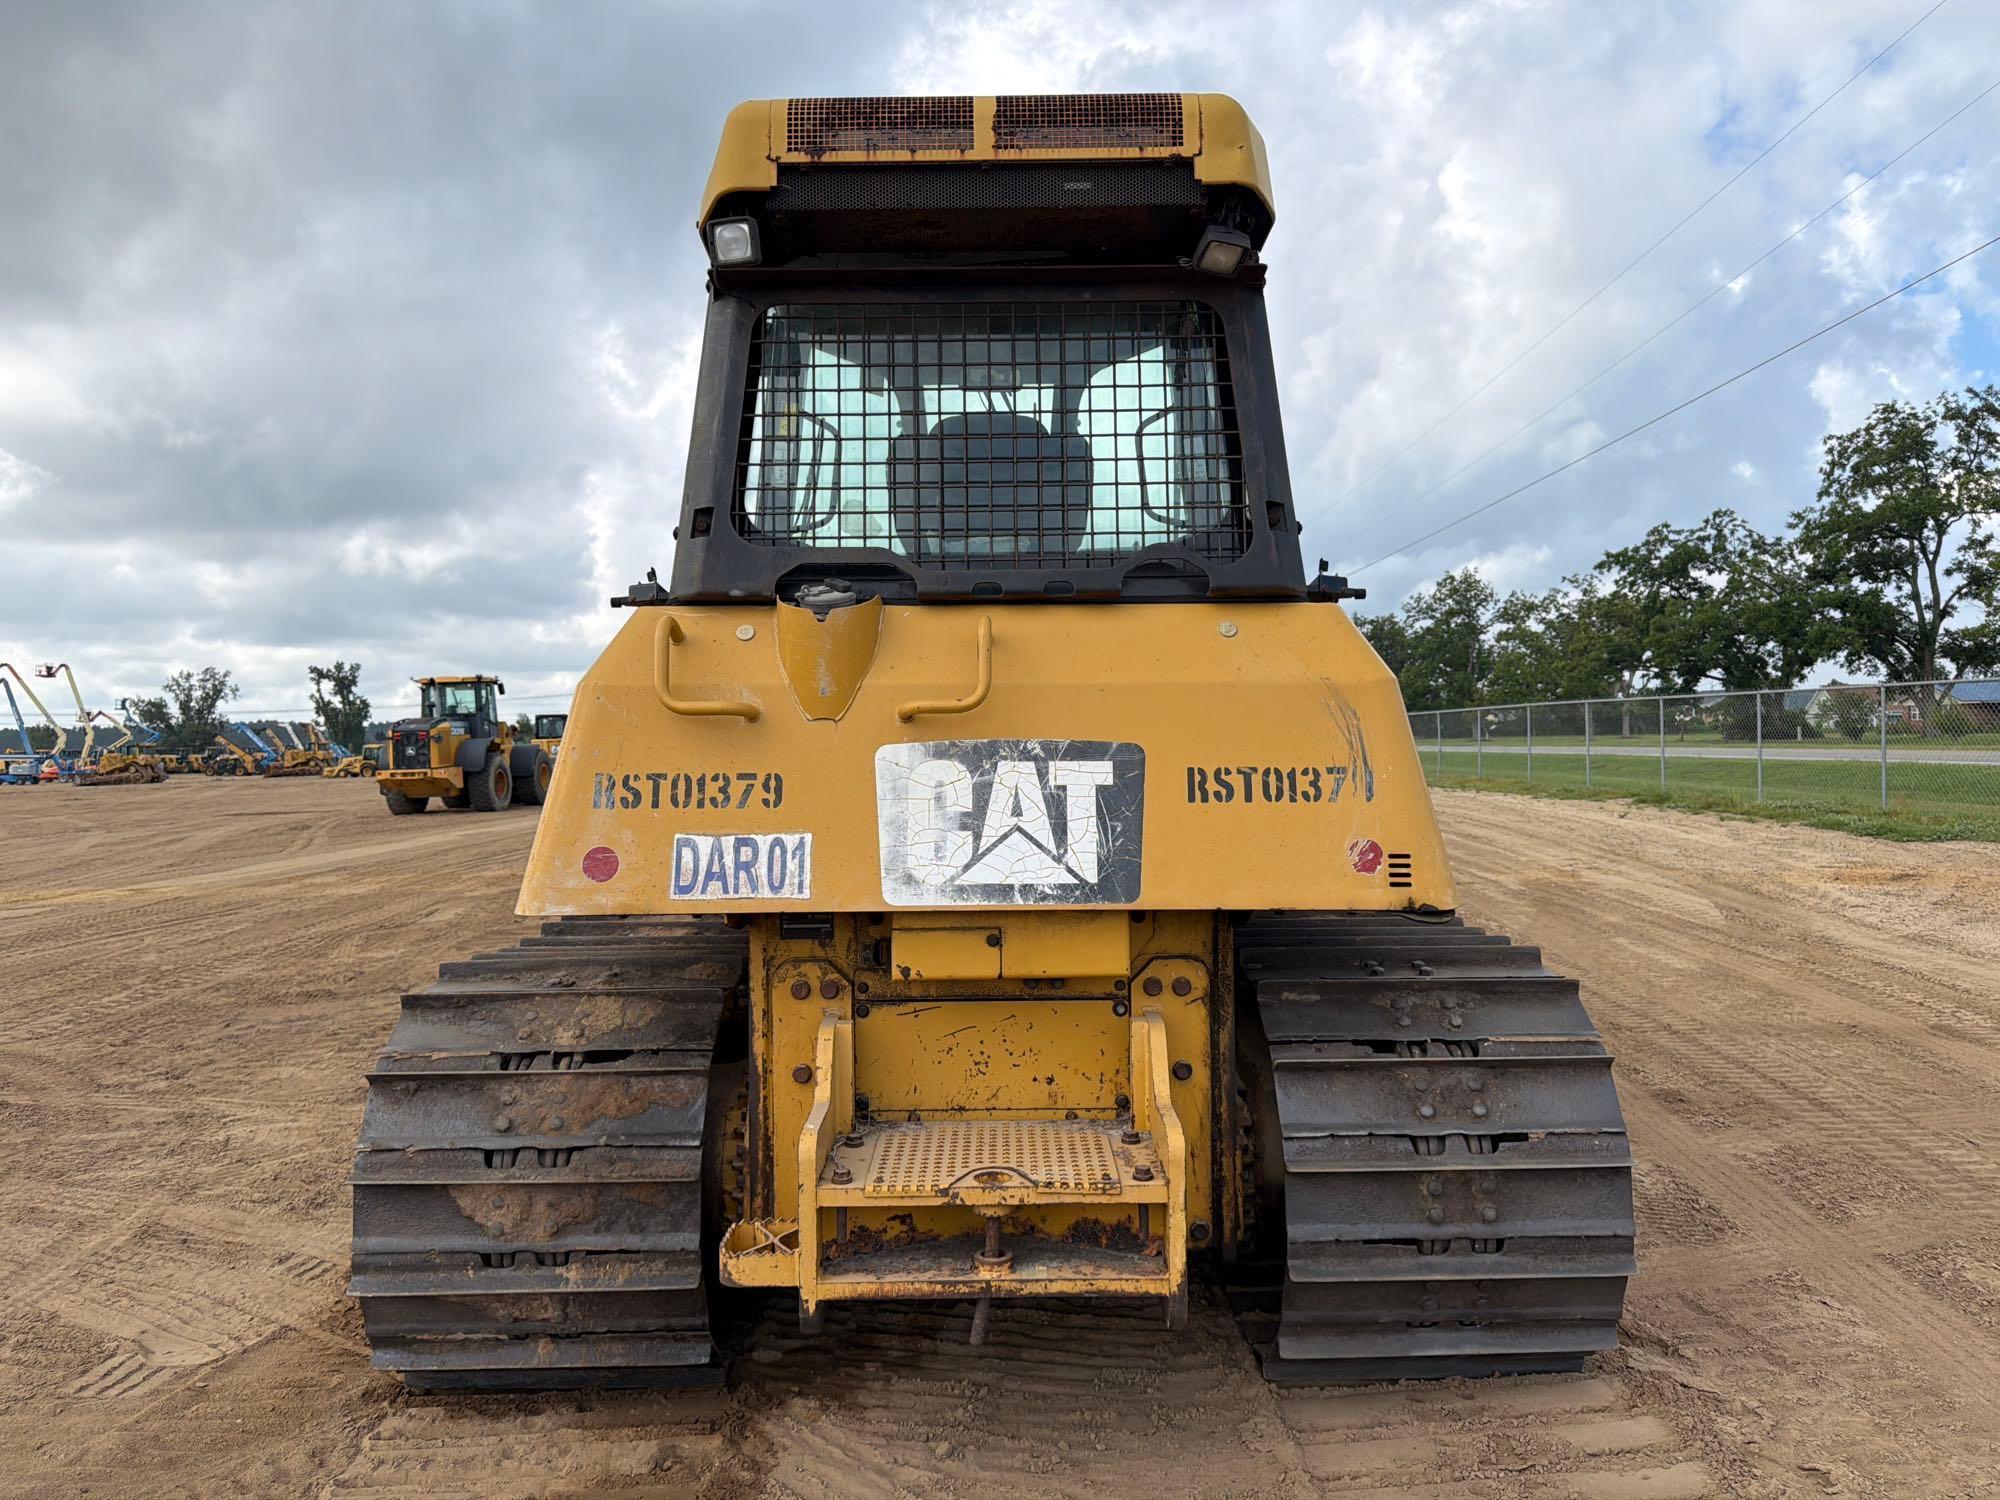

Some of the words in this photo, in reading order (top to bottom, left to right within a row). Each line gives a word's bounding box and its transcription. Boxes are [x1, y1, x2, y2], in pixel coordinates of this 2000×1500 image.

[592, 772, 783, 809] RST01379
[905, 758, 1114, 885] CAT
[674, 837, 806, 896] DAR01
